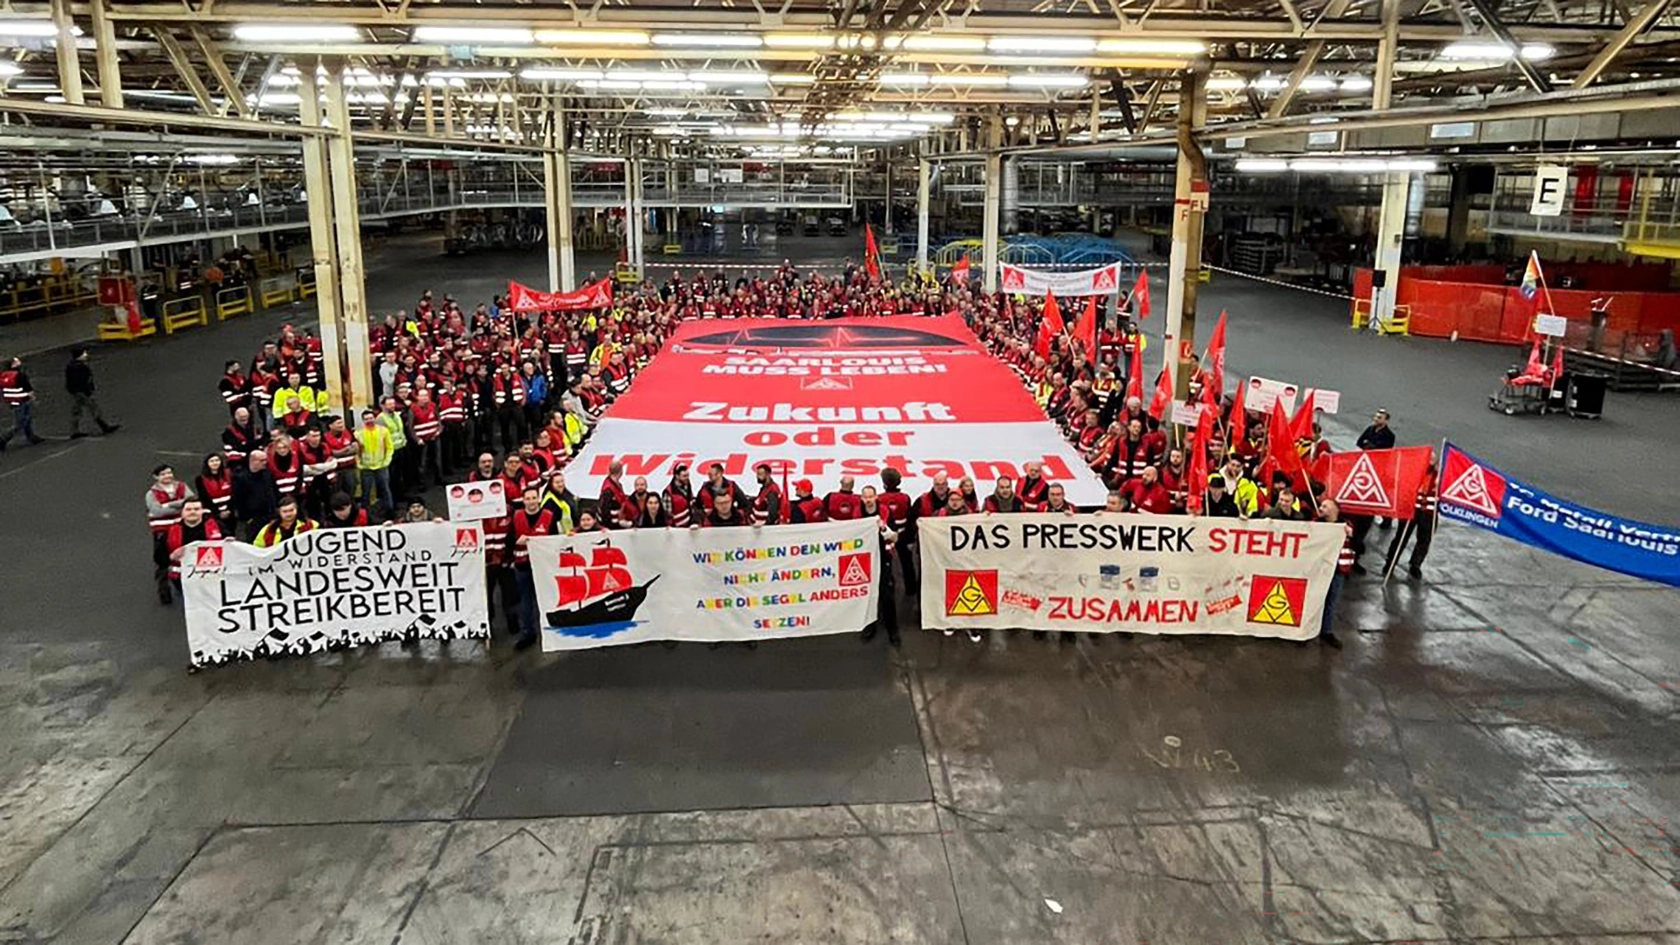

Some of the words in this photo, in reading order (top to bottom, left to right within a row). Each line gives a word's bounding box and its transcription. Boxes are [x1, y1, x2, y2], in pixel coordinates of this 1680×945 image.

[1538, 177, 1560, 205] E
[702, 365, 809, 376] MUSS
[820, 364, 947, 376] LEBEN!
[724, 357, 926, 366] SAARLOUIS
[682, 402, 957, 421] Zukunft
[743, 427, 915, 447] oder
[588, 453, 1076, 481] Widerstand
[1507, 496, 1559, 523] Ford
[273, 528, 407, 562] JUGEND
[692, 553, 721, 564] WIR
[724, 546, 787, 562] KÖNNEN
[790, 543, 821, 557] DEN
[824, 538, 864, 552] WIND
[950, 524, 1011, 552] DAS
[1022, 523, 1195, 553] PRESSWERK
[1208, 527, 1309, 558] STEHT
[249, 564, 274, 577] IM
[287, 549, 431, 570] WIDERSTAND
[724, 573, 767, 586] NICHT
[771, 566, 836, 583] ÄNDERN,
[220, 562, 459, 607] LANDESWEIT
[696, 597, 733, 609] ABER
[736, 596, 759, 608] DIE
[761, 592, 807, 606] SEGEL
[809, 586, 869, 602] ANDERS
[218, 588, 465, 633] STREIKBEREIT
[753, 616, 811, 629] SETZEN!
[1047, 595, 1199, 623] ZUSAMMEN
